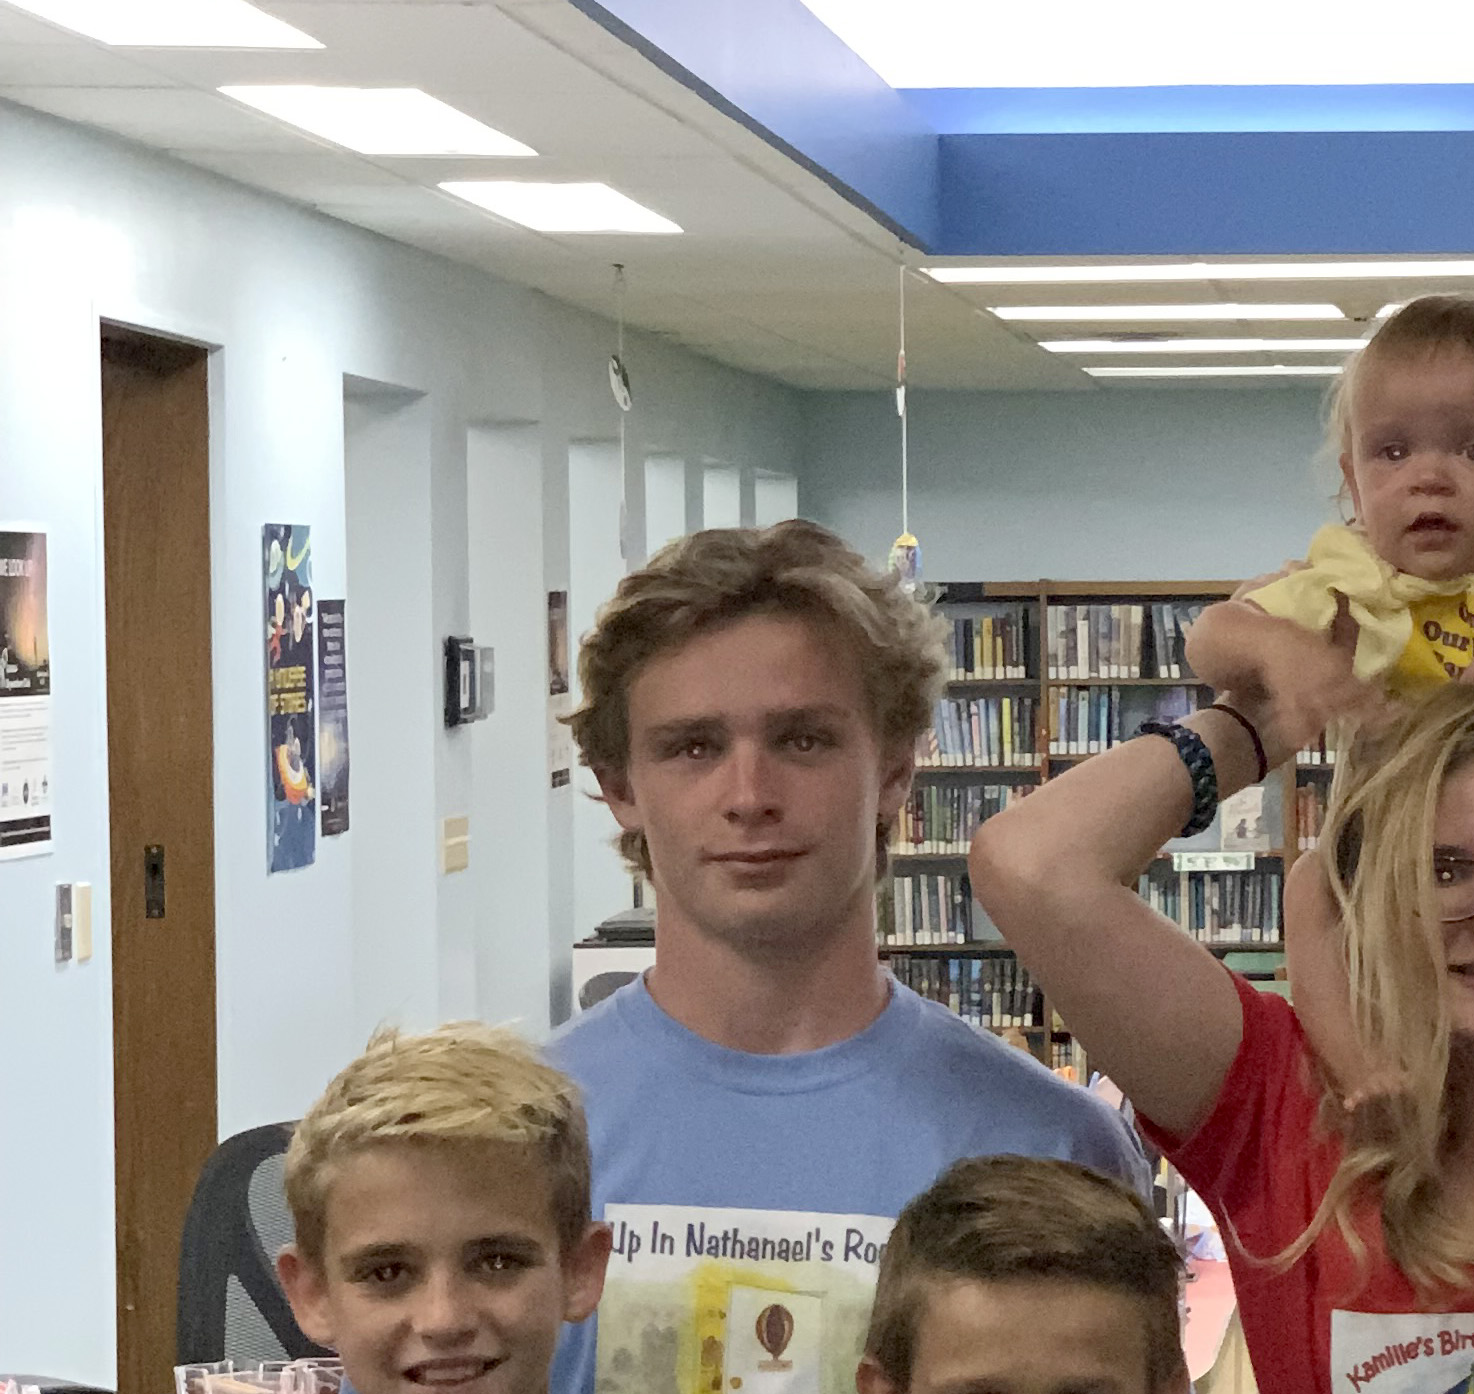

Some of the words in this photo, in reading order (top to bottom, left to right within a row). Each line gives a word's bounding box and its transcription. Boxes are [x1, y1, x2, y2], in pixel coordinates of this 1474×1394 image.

[1423, 620, 1470, 652] Our
[609, 1220, 637, 1263] Up
[651, 1220, 675, 1256] In
[686, 1222, 834, 1263] Nathanael's
